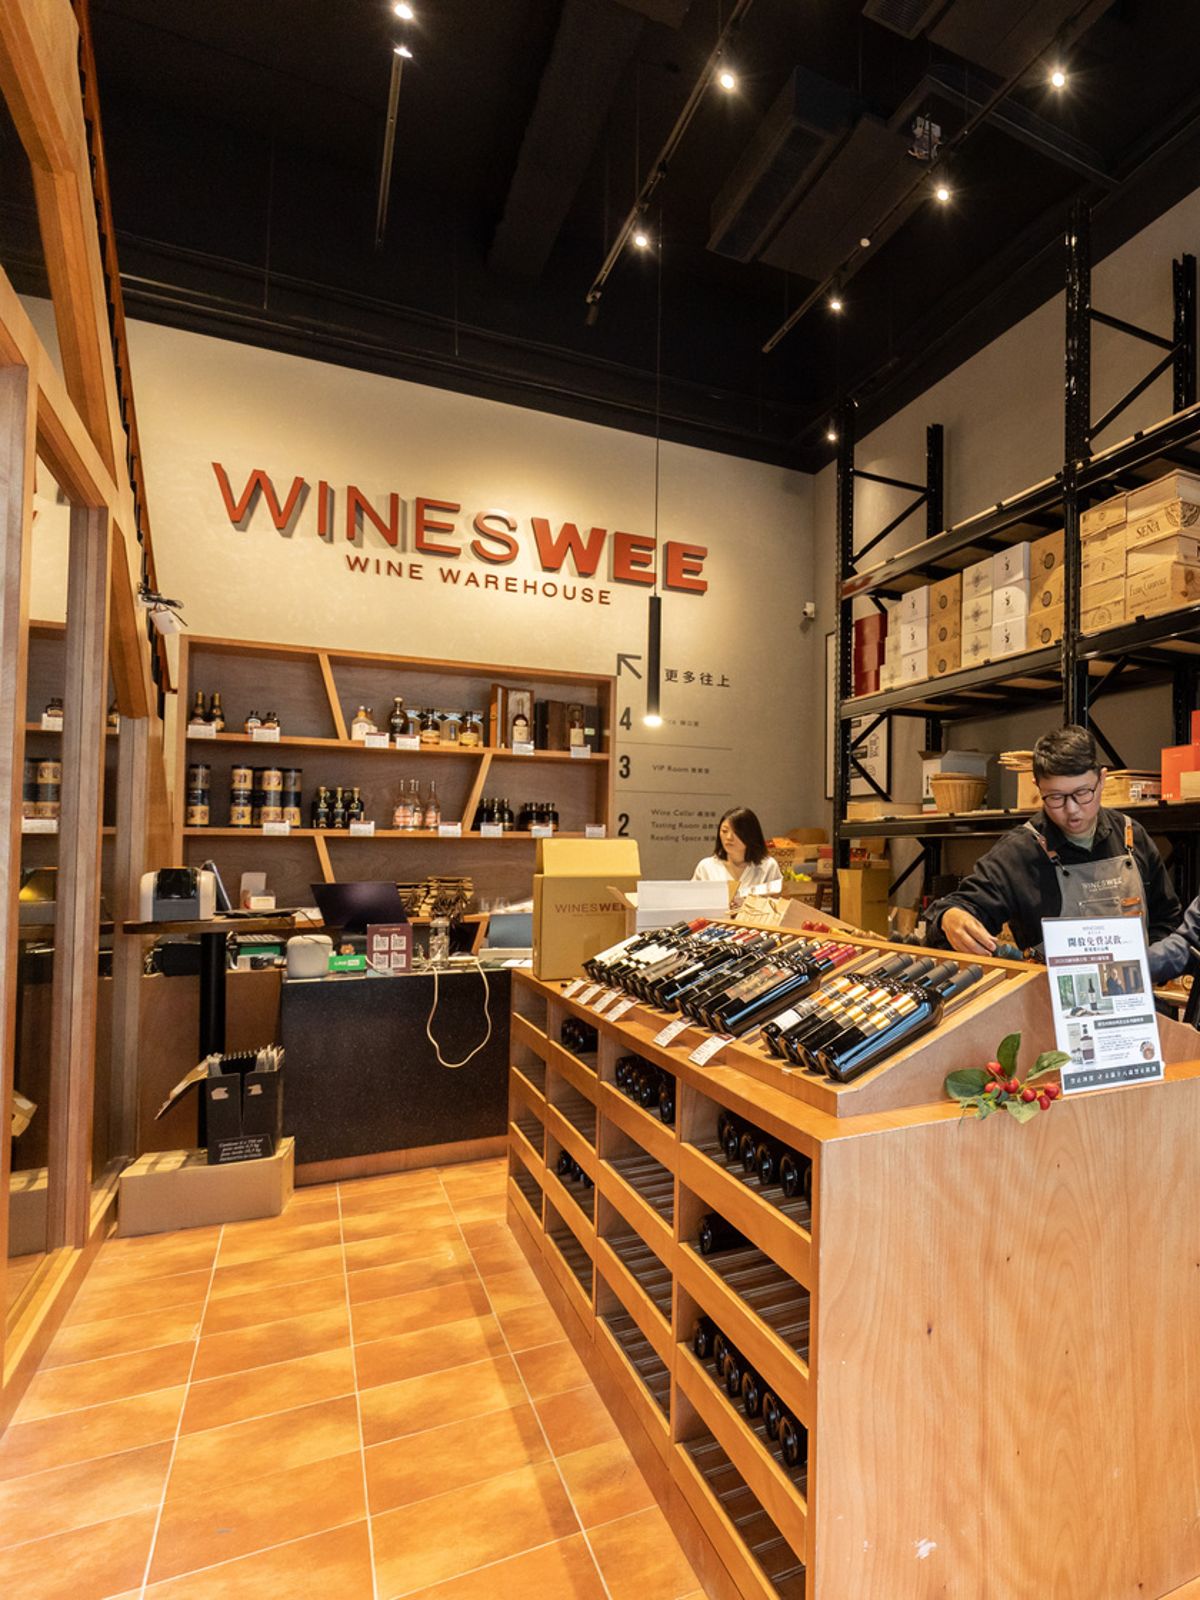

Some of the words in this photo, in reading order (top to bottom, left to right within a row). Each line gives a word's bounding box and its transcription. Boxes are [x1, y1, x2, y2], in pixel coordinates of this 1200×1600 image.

[212, 462, 708, 595] WINESWEE
[346, 554, 424, 581] WINE
[440, 567, 612, 605] WAREHOUSE
[664, 668, 731, 688] 更多往上
[619, 707, 632, 731] 4
[619, 755, 631, 779] 3
[618, 813, 630, 837] 2
[651, 821, 677, 830] Tasting
